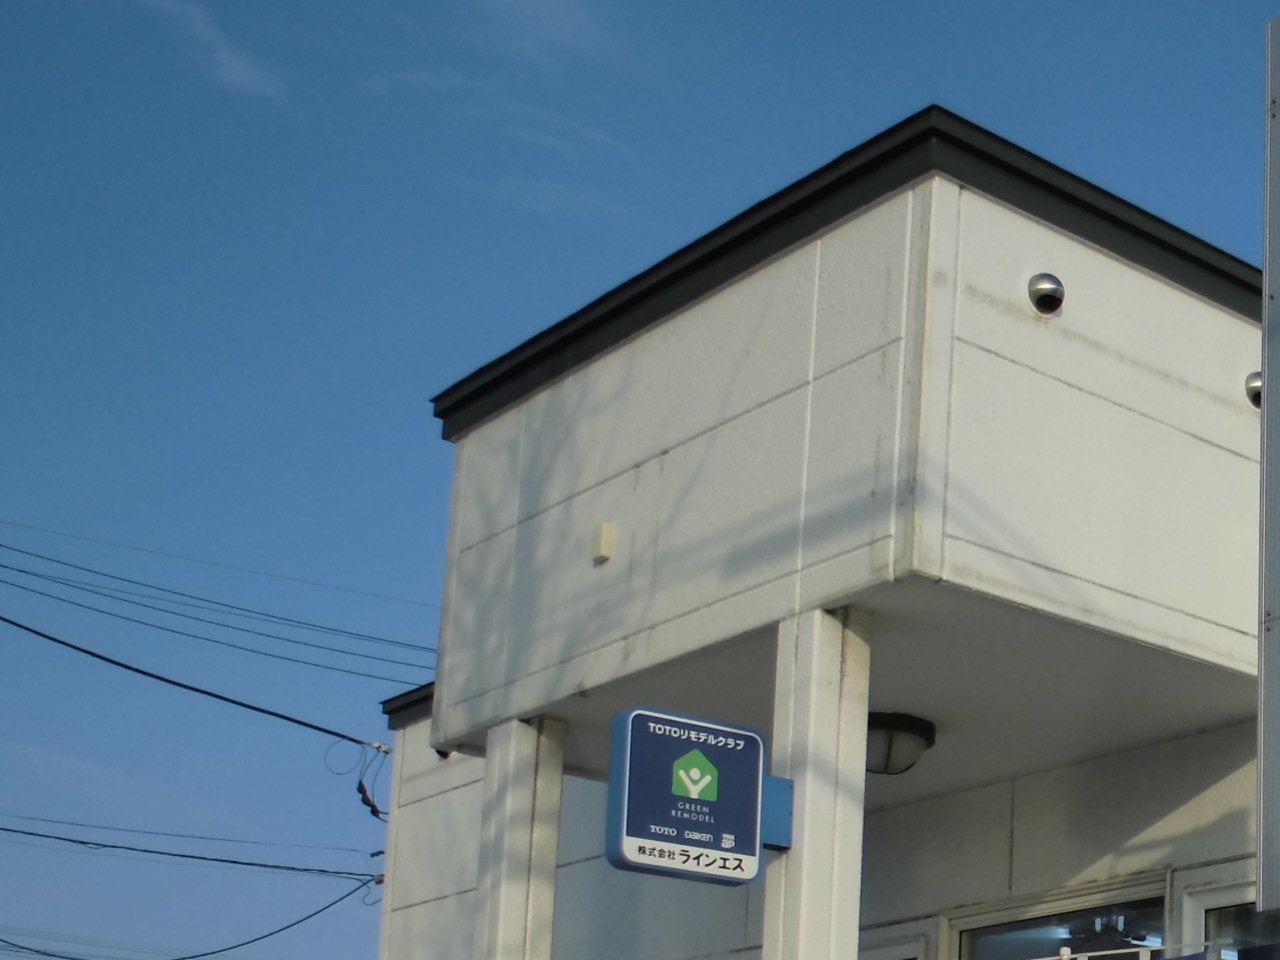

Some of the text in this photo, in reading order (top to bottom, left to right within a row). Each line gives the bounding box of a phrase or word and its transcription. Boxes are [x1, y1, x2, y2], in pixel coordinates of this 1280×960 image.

[648, 722, 745, 750] TOTOリモデルクラブ
[678, 801, 710, 813] GREEN
[671, 810, 715, 824] REMODEL
[650, 825, 677, 837] TOTO
